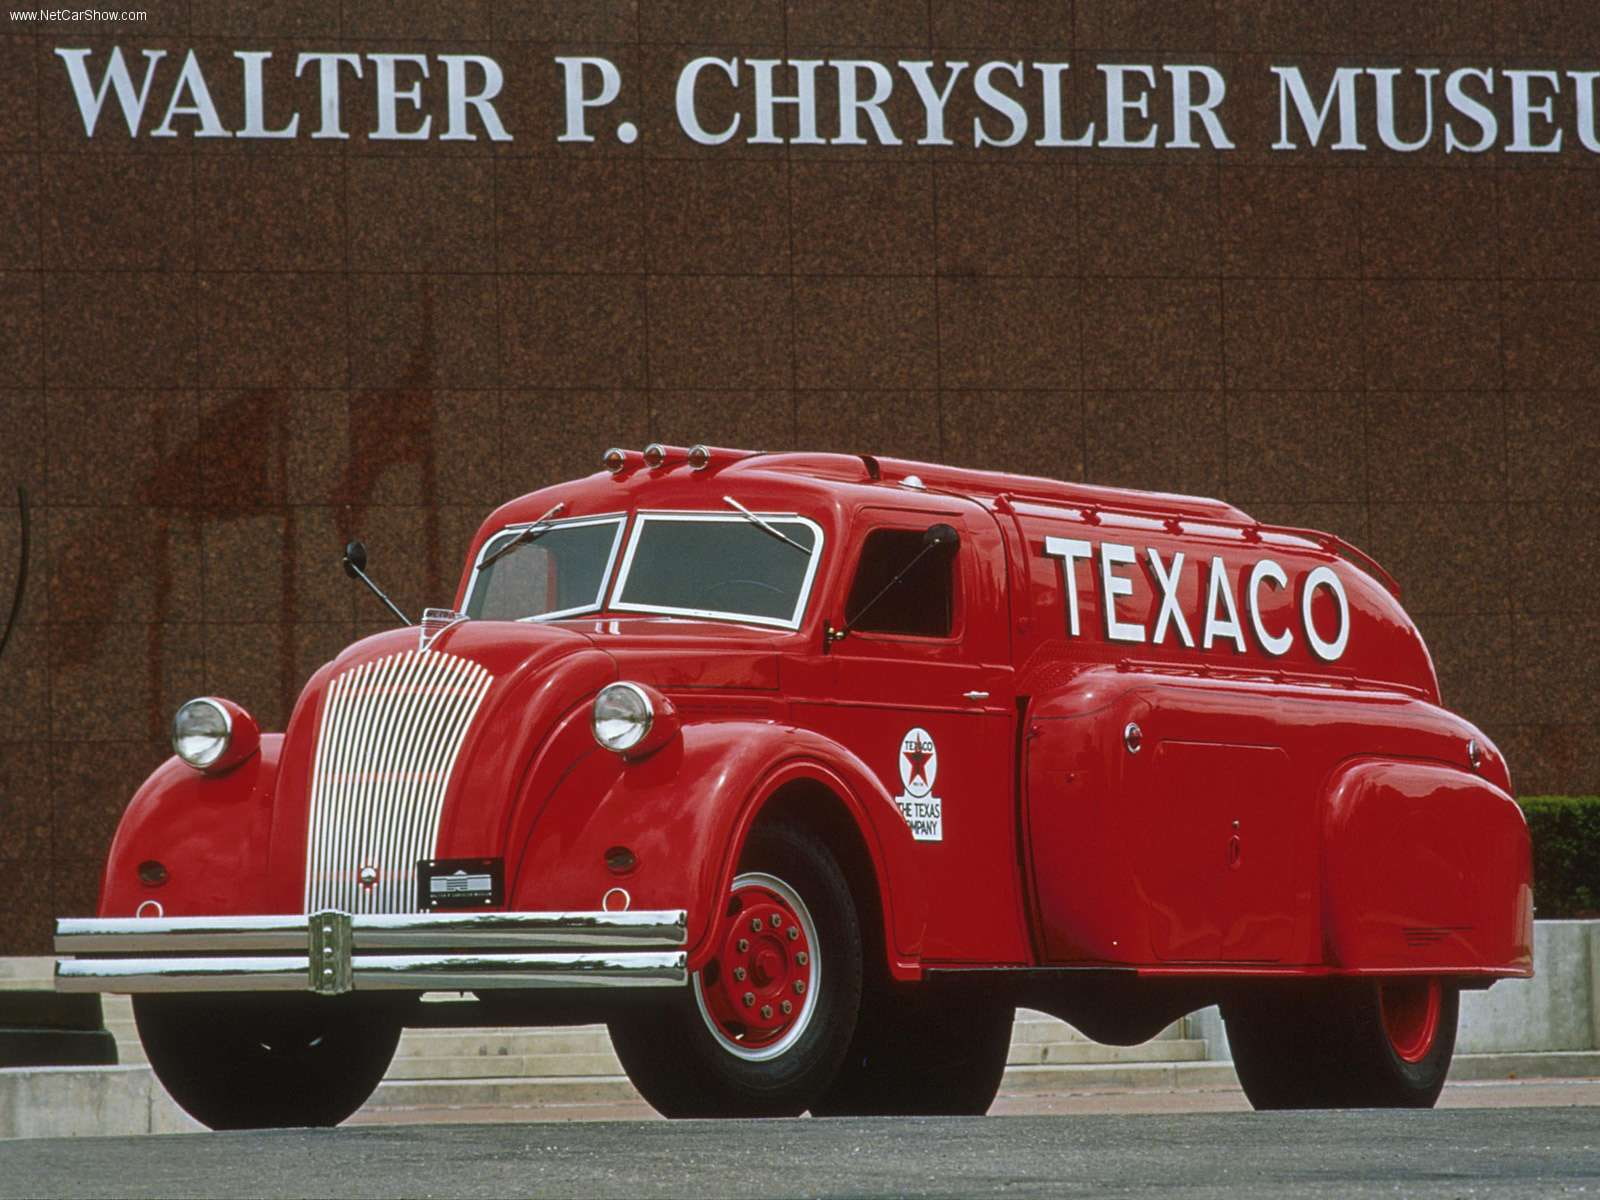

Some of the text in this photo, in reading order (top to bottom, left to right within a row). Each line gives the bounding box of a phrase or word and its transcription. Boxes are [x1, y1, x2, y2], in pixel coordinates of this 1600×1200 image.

[54, 46, 514, 142] WALTER
[555, 56, 638, 144] P.
[675, 56, 1235, 150] CHRYSLER
[1044, 536, 1351, 661] TEXACO
[914, 802, 940, 818] TEXAS
